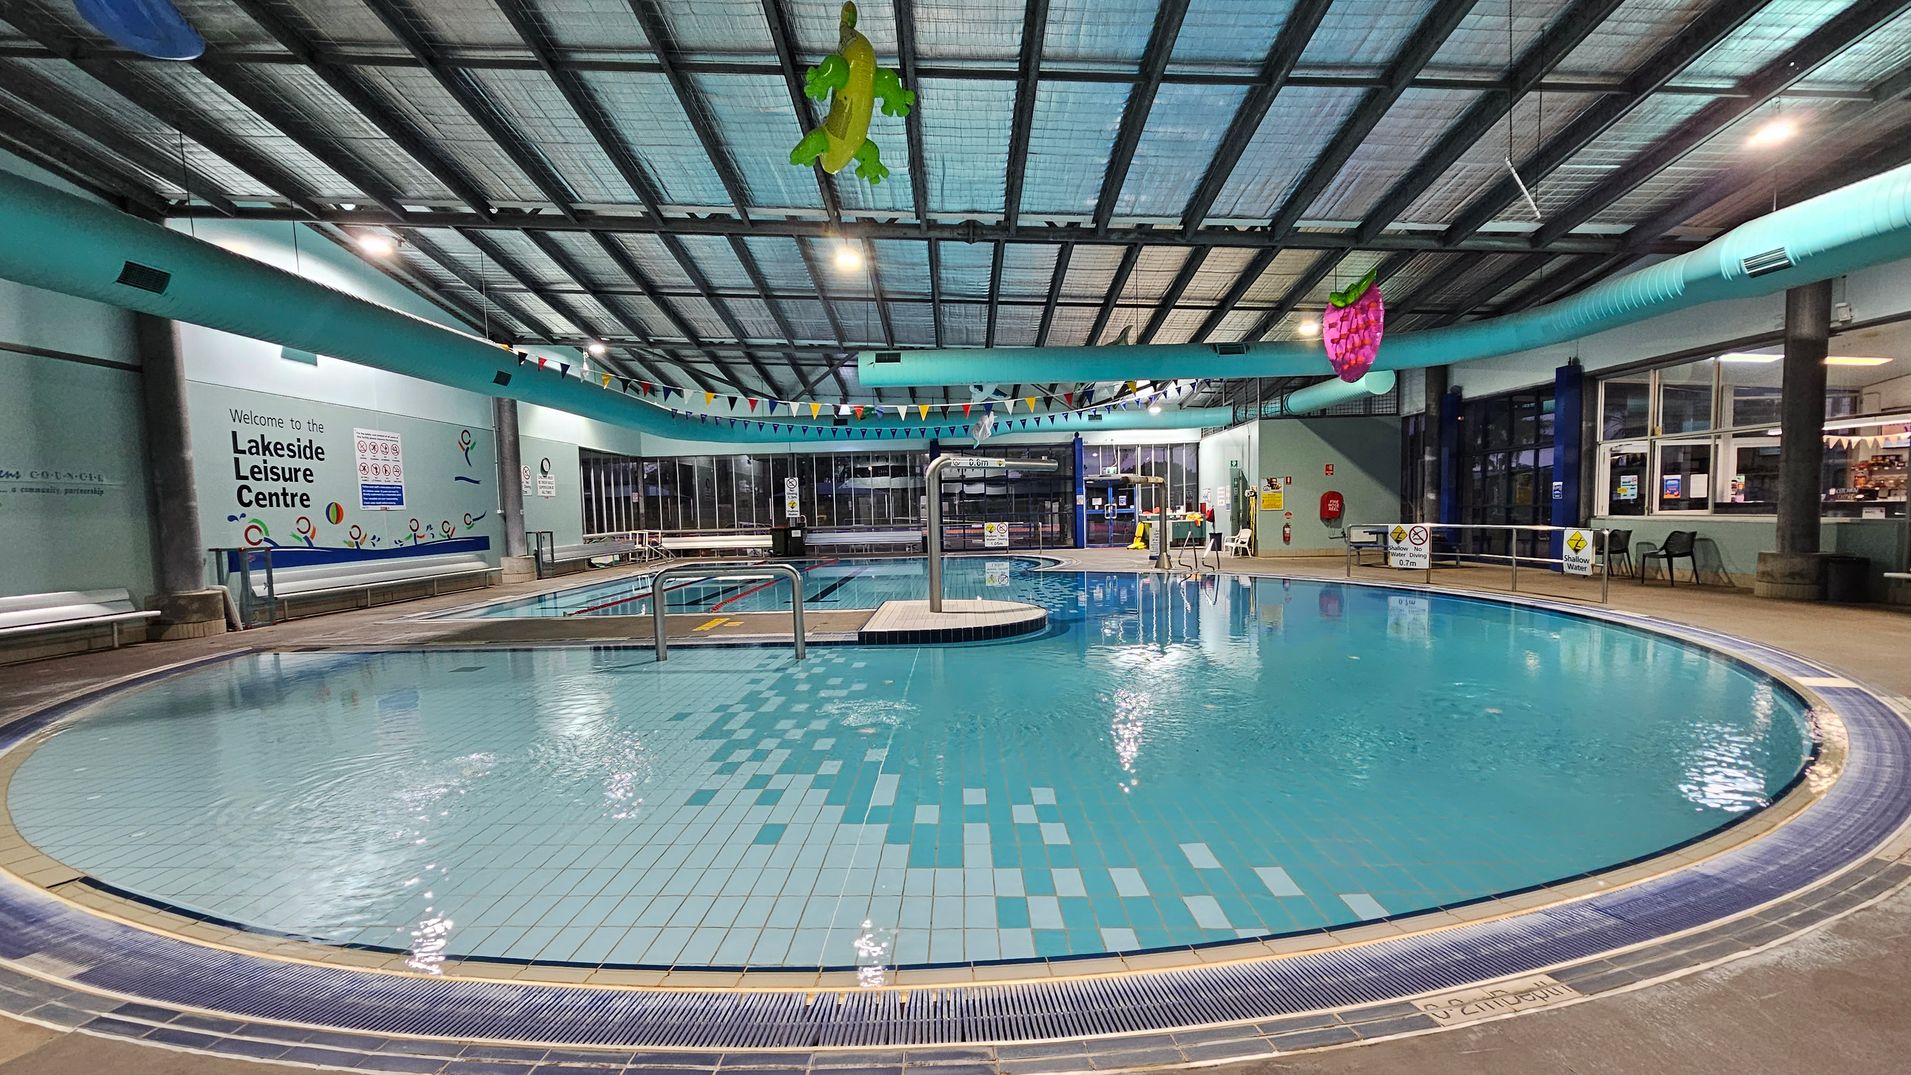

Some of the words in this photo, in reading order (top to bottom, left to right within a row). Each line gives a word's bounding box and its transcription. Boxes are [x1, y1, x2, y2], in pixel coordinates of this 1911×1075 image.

[229, 408, 284, 429] Welcome
[290, 417, 302, 430] to
[307, 418, 324, 433] the
[231, 430, 325, 461] Lakeside
[233, 457, 314, 483] Leisure
[236, 484, 311, 508] Centre
[1398, 559, 1417, 567] 0.7m
[1409, 552, 1427, 560] Diving
[1563, 554, 1590, 565] Shallow
[1566, 562, 1588, 572] Water
